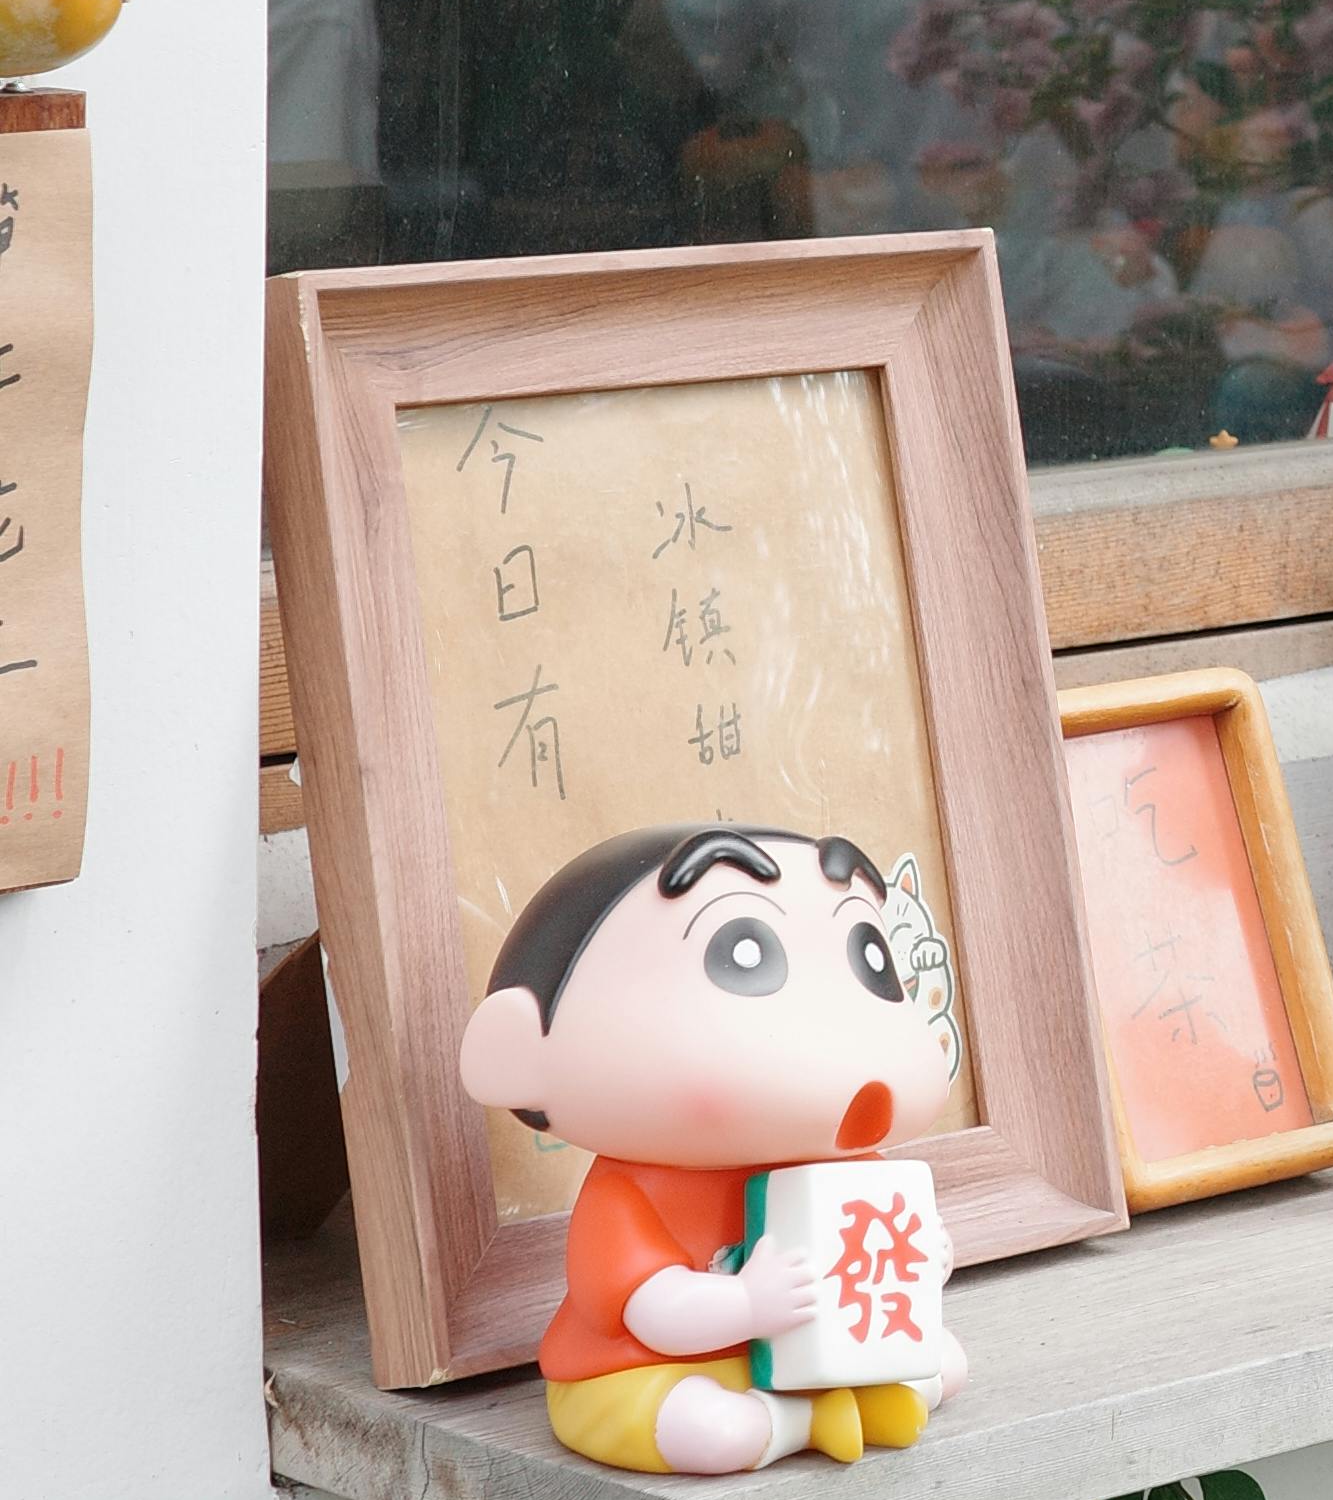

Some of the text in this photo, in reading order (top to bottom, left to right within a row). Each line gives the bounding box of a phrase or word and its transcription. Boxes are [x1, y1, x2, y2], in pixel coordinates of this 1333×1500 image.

[455, 405, 567, 801] 今日有
[651, 482, 743, 825] 冰镇甜
[822, 1190, 928, 1344] 發
